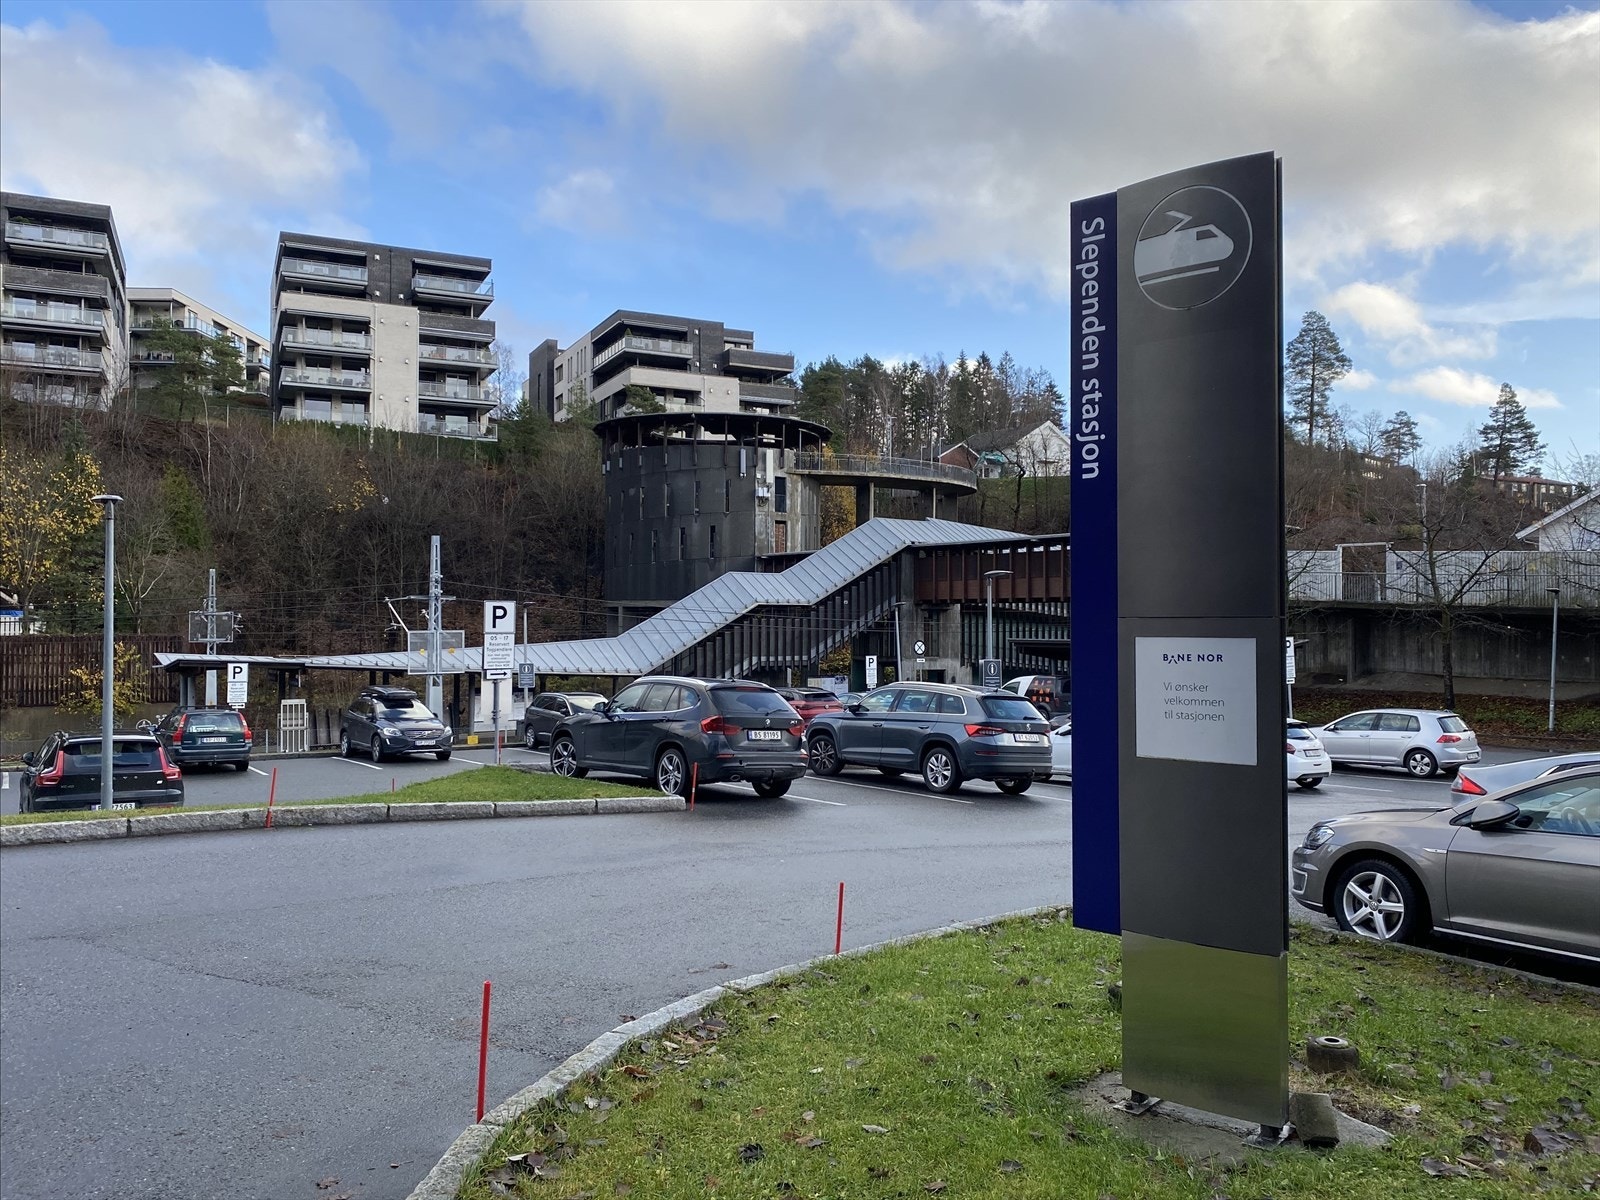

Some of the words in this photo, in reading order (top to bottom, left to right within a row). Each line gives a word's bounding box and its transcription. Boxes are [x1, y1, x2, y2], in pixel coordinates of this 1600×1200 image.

[1076, 217, 1106, 370] Slependen
[1076, 378, 1105, 479] stasjon
[493, 606, 507, 628] P
[868, 657, 875, 667] P
[1163, 653, 1192, 664] BANE
[1198, 653, 1223, 662] NOR
[232, 665, 243, 680] P
[1163, 682, 1172, 691] Vi
[1175, 682, 1208, 692] ønsker
[1164, 695, 1225, 707] velkommen
[1165, 709, 1173, 719] til
[1175, 710, 1225, 722] stasjonen
[754, 731, 761, 739] BS
[763, 731, 779, 739] 81195
